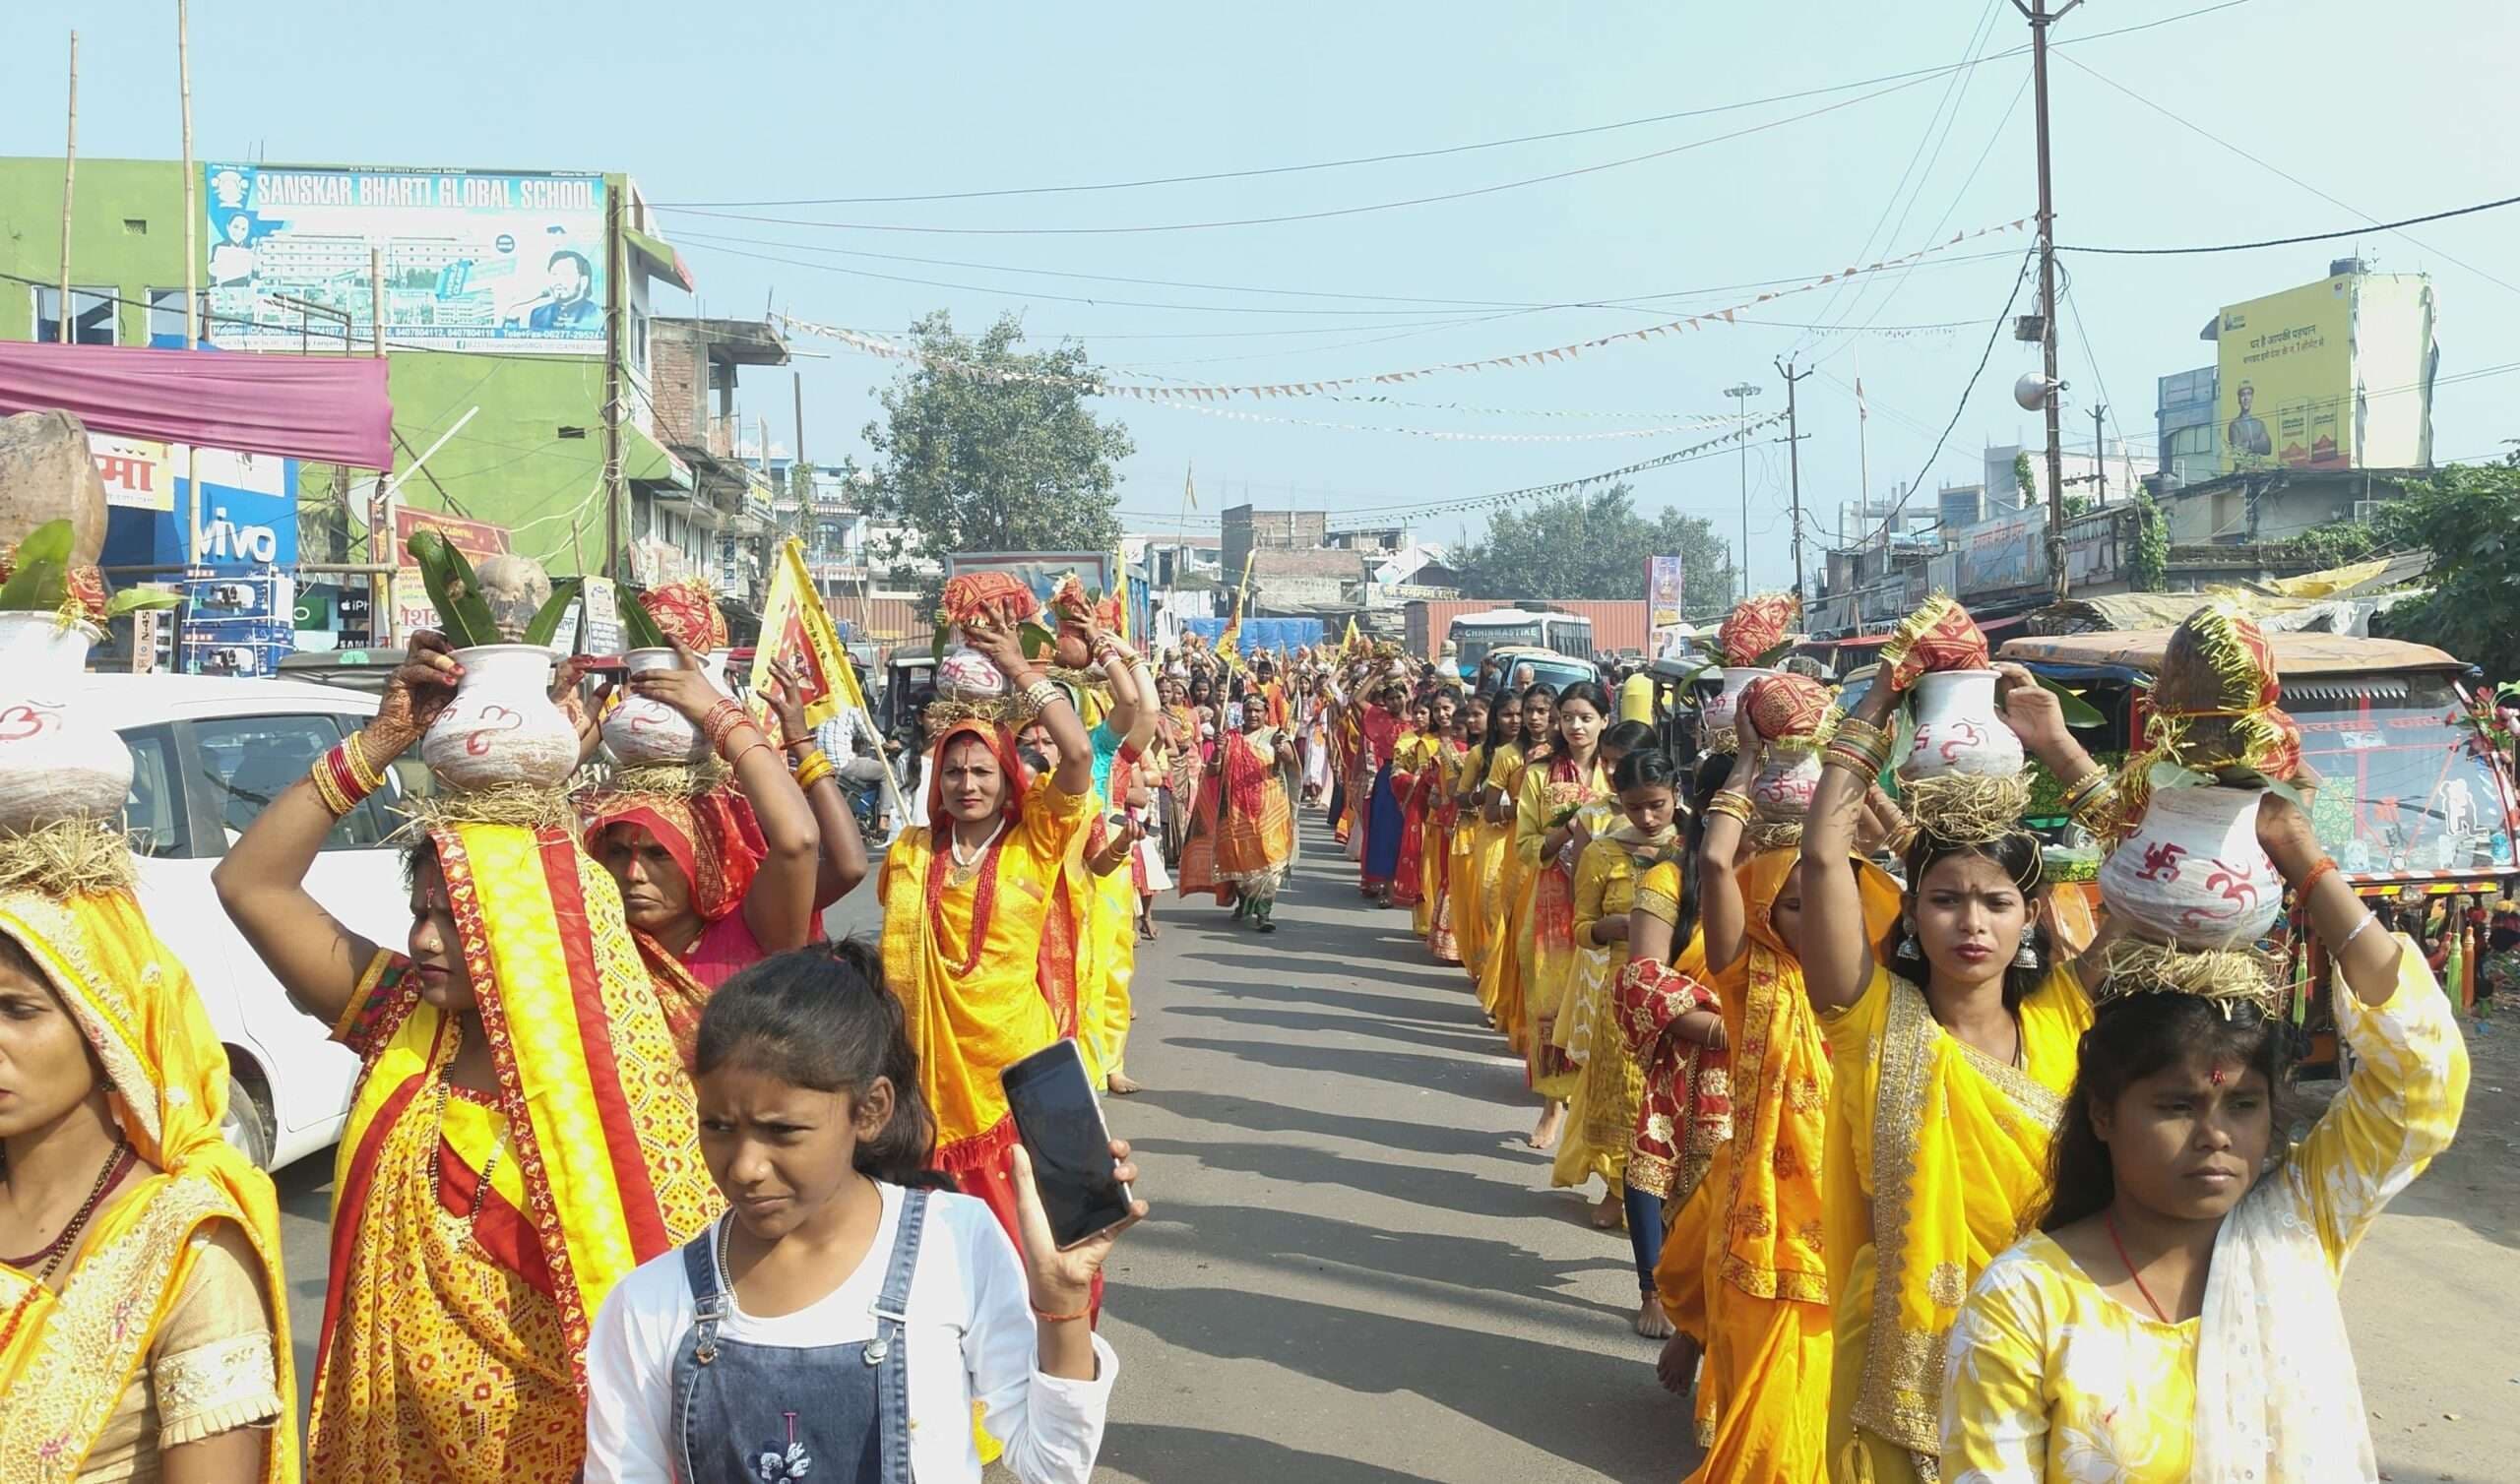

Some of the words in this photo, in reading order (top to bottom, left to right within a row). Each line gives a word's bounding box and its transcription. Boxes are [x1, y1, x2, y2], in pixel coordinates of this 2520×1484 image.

[257, 173, 352, 206] SANSKAR
[359, 176, 431, 208] BHARTI
[439, 178, 515, 209] GLOBAL
[520, 180, 599, 210] SCHOOL
[199, 507, 277, 563] vivo
[340, 640, 370, 649] SAM
